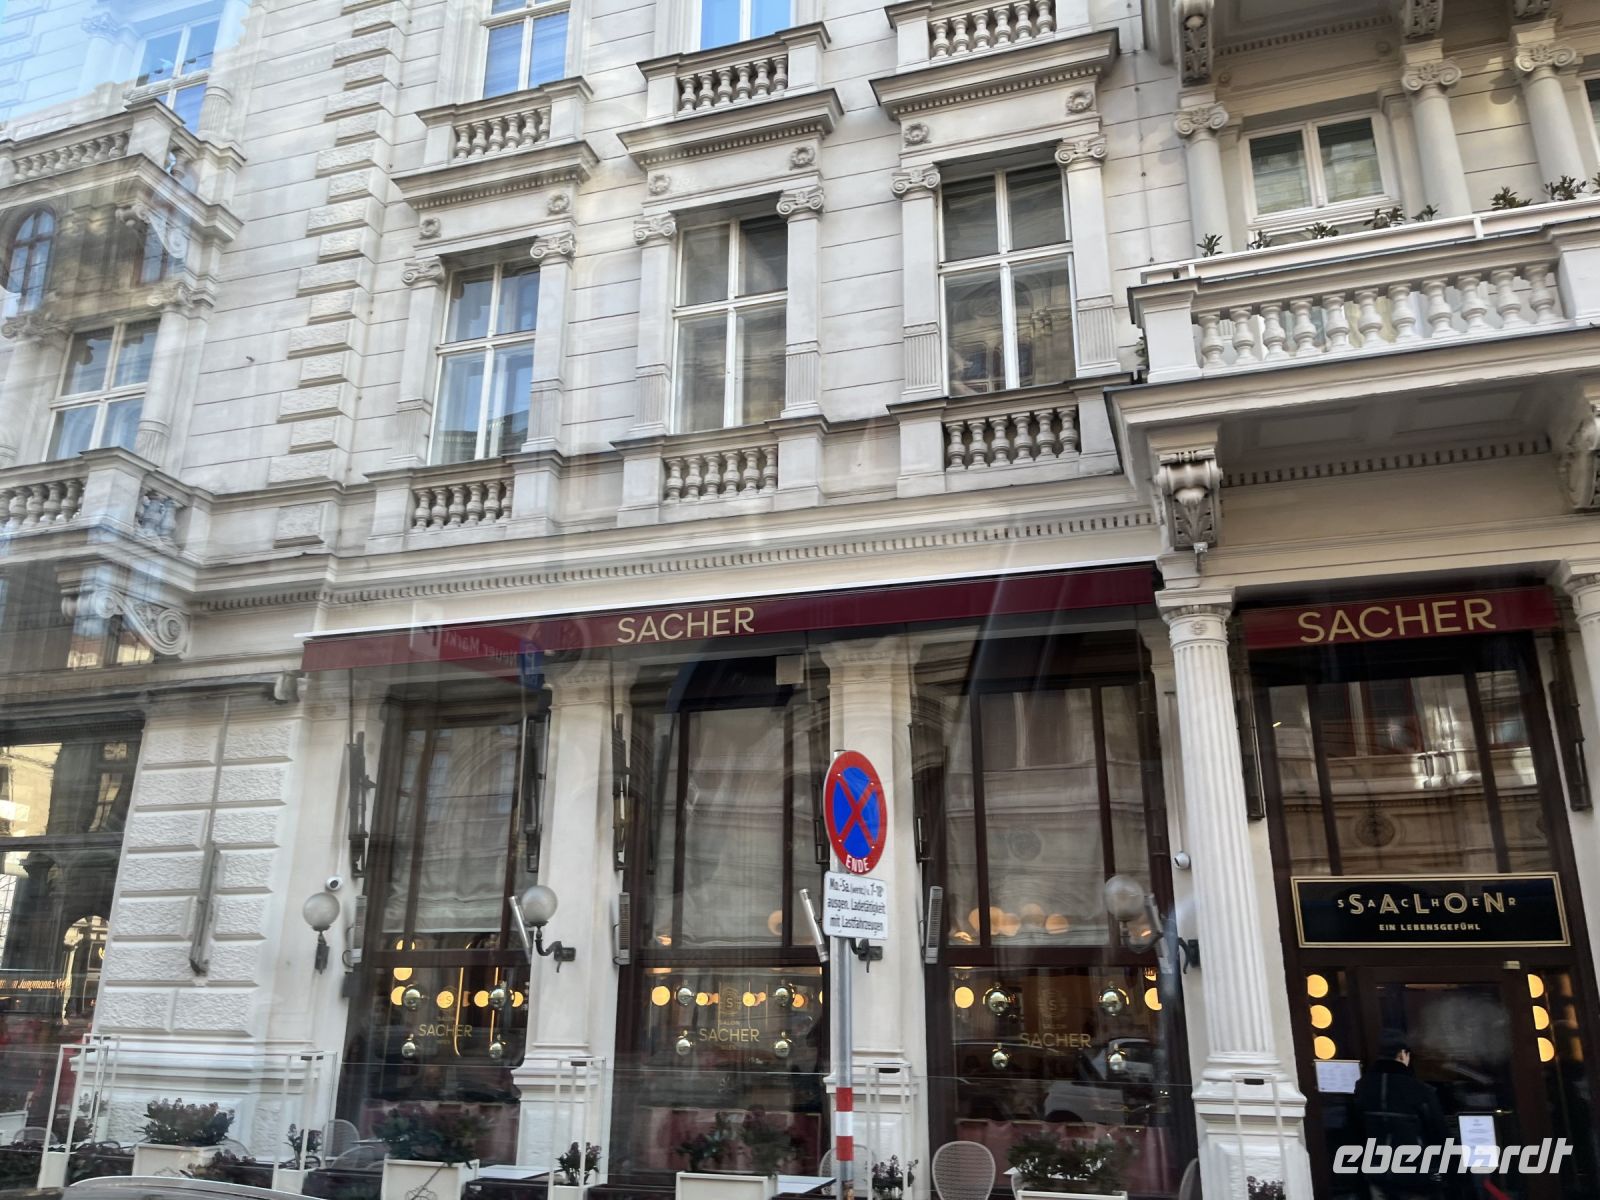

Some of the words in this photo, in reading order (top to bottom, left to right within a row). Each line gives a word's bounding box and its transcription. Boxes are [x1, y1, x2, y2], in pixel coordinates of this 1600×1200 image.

[617, 606, 755, 643] SACHER
[1298, 598, 1496, 643] SACHER
[845, 854, 870, 873] ENDE
[1400, 922, 1481, 931] LEBENSGEFÜHL
[419, 1024, 473, 1038] SACHER
[699, 1028, 760, 1042] SACHER
[1020, 1032, 1092, 1048] SACHER
